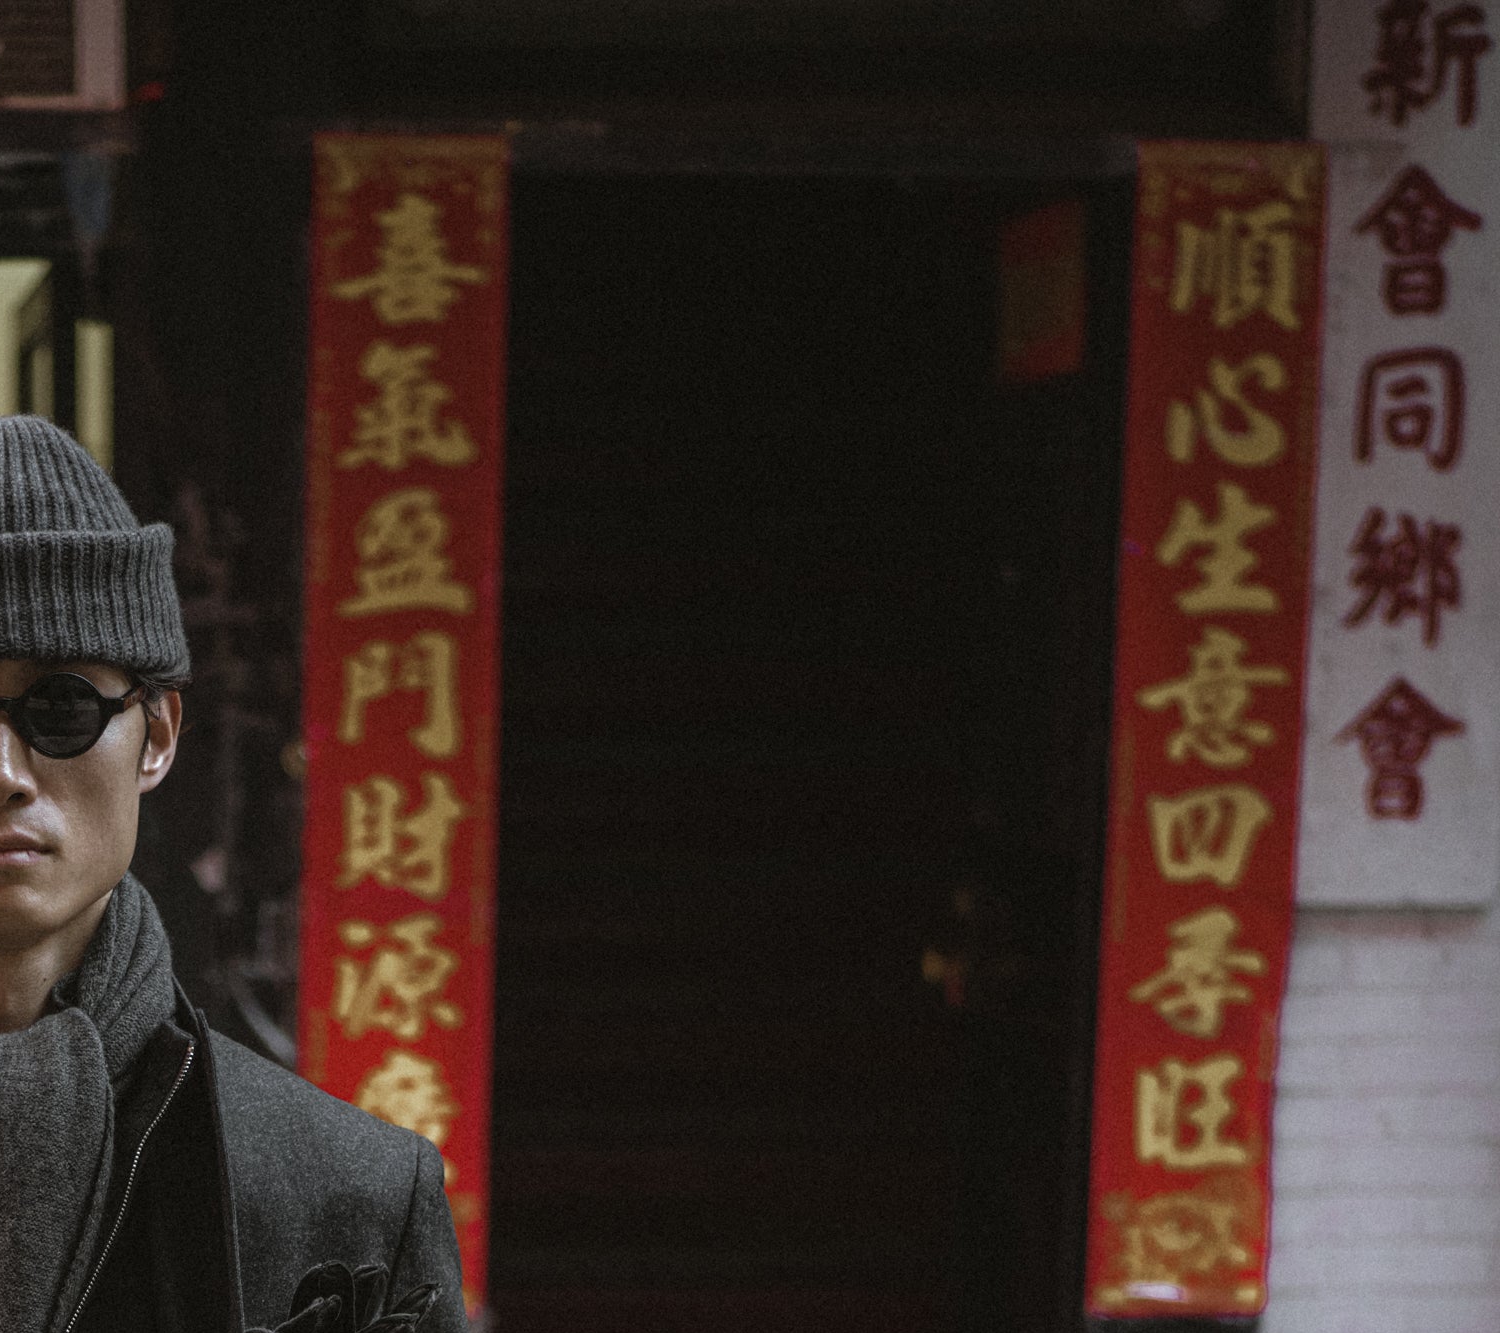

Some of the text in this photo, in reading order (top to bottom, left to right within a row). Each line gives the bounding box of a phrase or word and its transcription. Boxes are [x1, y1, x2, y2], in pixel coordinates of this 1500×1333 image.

[1127, 202, 1300, 1170] 順心生意四季旺
[1332, 0, 1492, 822] 新會同鄉會
